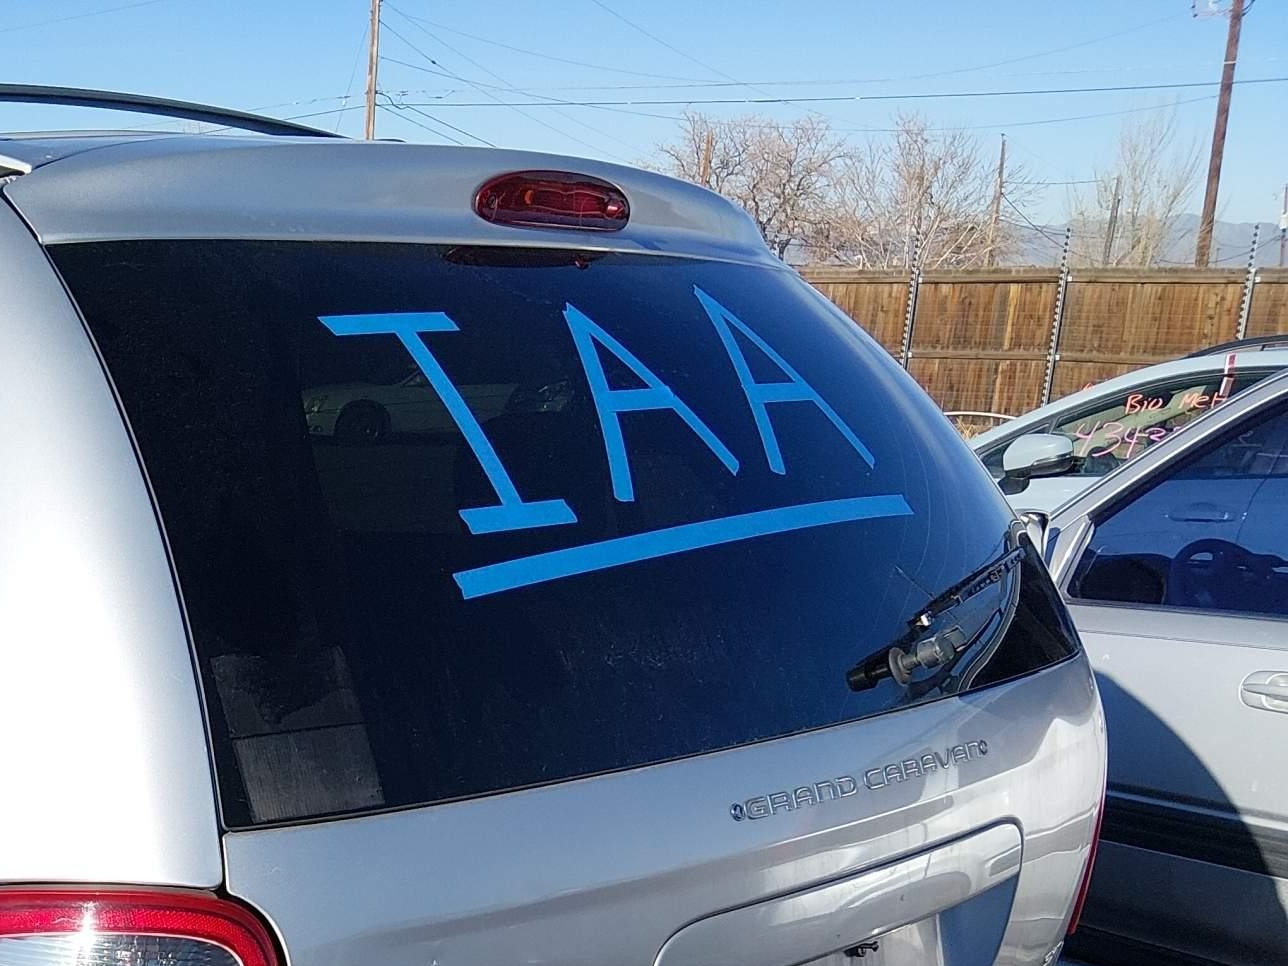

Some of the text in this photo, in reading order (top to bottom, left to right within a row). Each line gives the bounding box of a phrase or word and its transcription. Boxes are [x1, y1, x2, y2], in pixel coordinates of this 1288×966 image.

[317, 284, 875, 534] IAA
[743, 740, 982, 820] GRAND CARAVAN
